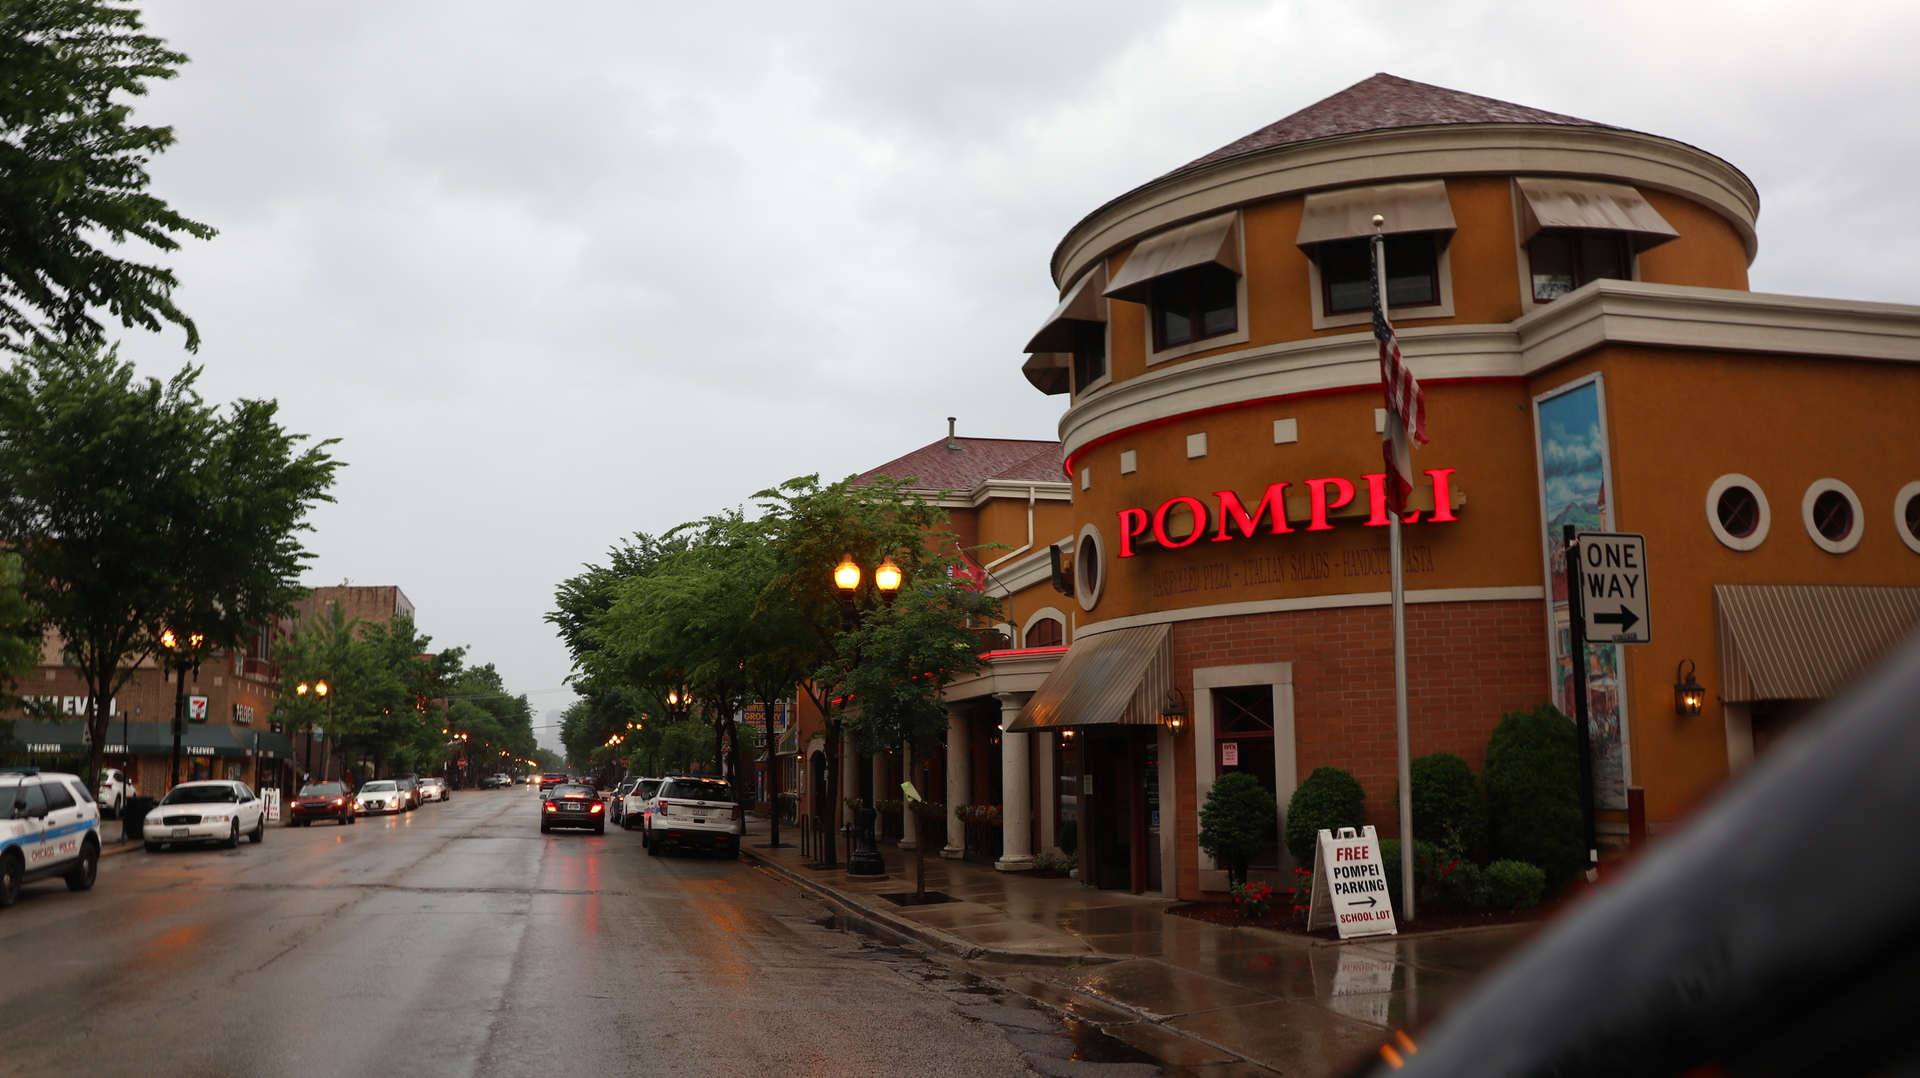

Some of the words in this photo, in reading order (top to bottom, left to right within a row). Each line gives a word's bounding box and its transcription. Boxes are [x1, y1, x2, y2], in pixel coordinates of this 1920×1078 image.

[1587, 543, 1637, 568] ONE
[1203, 563, 1231, 590] PIZZA
[1243, 556, 1285, 586] ITALIAN
[1291, 552, 1329, 581] SALADS
[1342, 547, 1391, 577] HANDCUT
[1587, 573, 1639, 598] WAY
[744, 704, 764, 712] AMPUS
[744, 712, 782, 720] GROCRY
[31, 846, 55, 862] CHICAGO
[59, 839, 77, 854] POLICE
[1336, 846, 1369, 862] FREE
[1333, 863, 1380, 879] POMPEI
[1334, 879, 1385, 895] PARKING
[1340, 911, 1374, 923] SCHOOL
[1375, 910, 1390, 920] LOT
